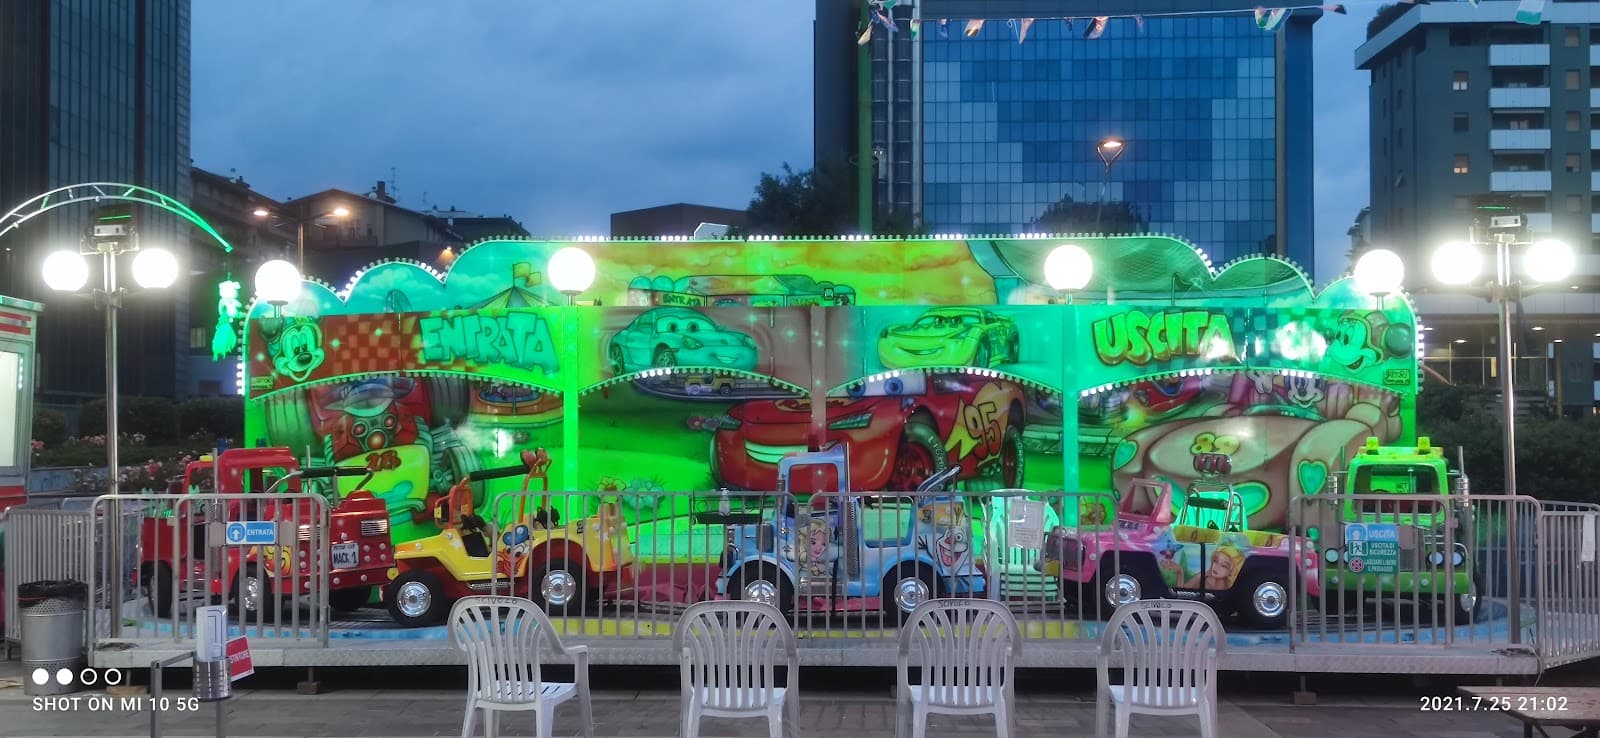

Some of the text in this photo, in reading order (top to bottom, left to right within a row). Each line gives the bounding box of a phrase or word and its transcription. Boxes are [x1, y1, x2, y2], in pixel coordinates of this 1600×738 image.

[419, 311, 559, 375] ENTRATA
[1092, 310, 1242, 366] USCITA
[963, 401, 1002, 460] 95
[333, 551, 357, 565] MACK 1
[1369, 530, 1396, 539] USCITA
